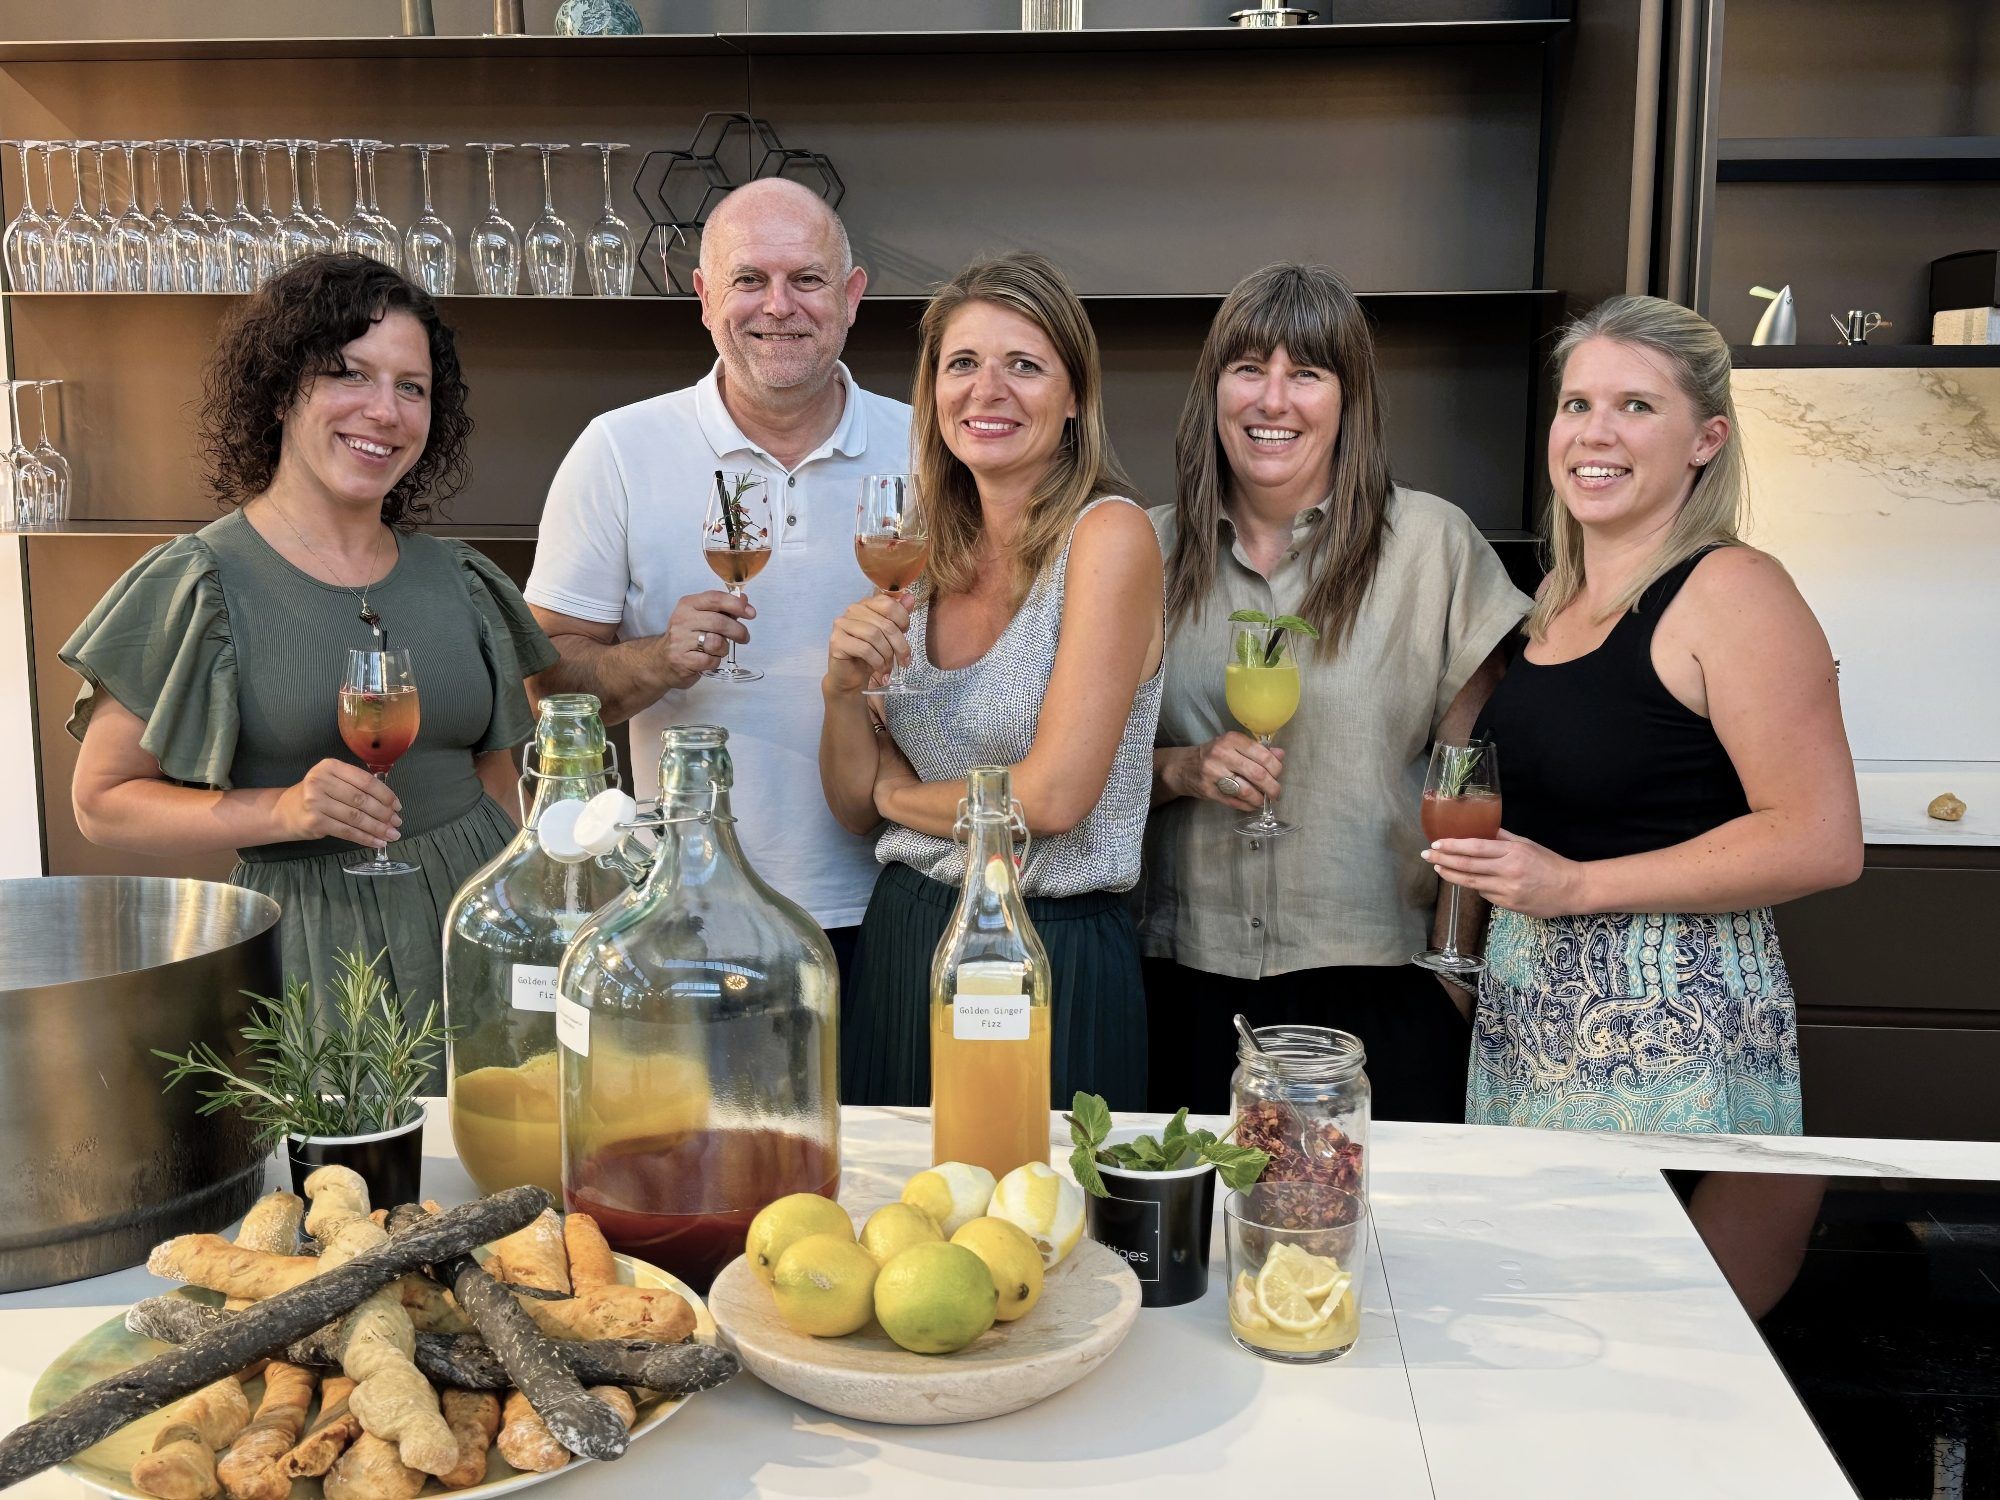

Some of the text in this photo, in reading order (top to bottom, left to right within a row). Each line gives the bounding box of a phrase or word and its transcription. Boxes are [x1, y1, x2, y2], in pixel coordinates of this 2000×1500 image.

[518, 976, 547, 986] Golden
[959, 1006, 1024, 1016] Golden Ginger
[981, 1019, 1001, 1028] Fizz
